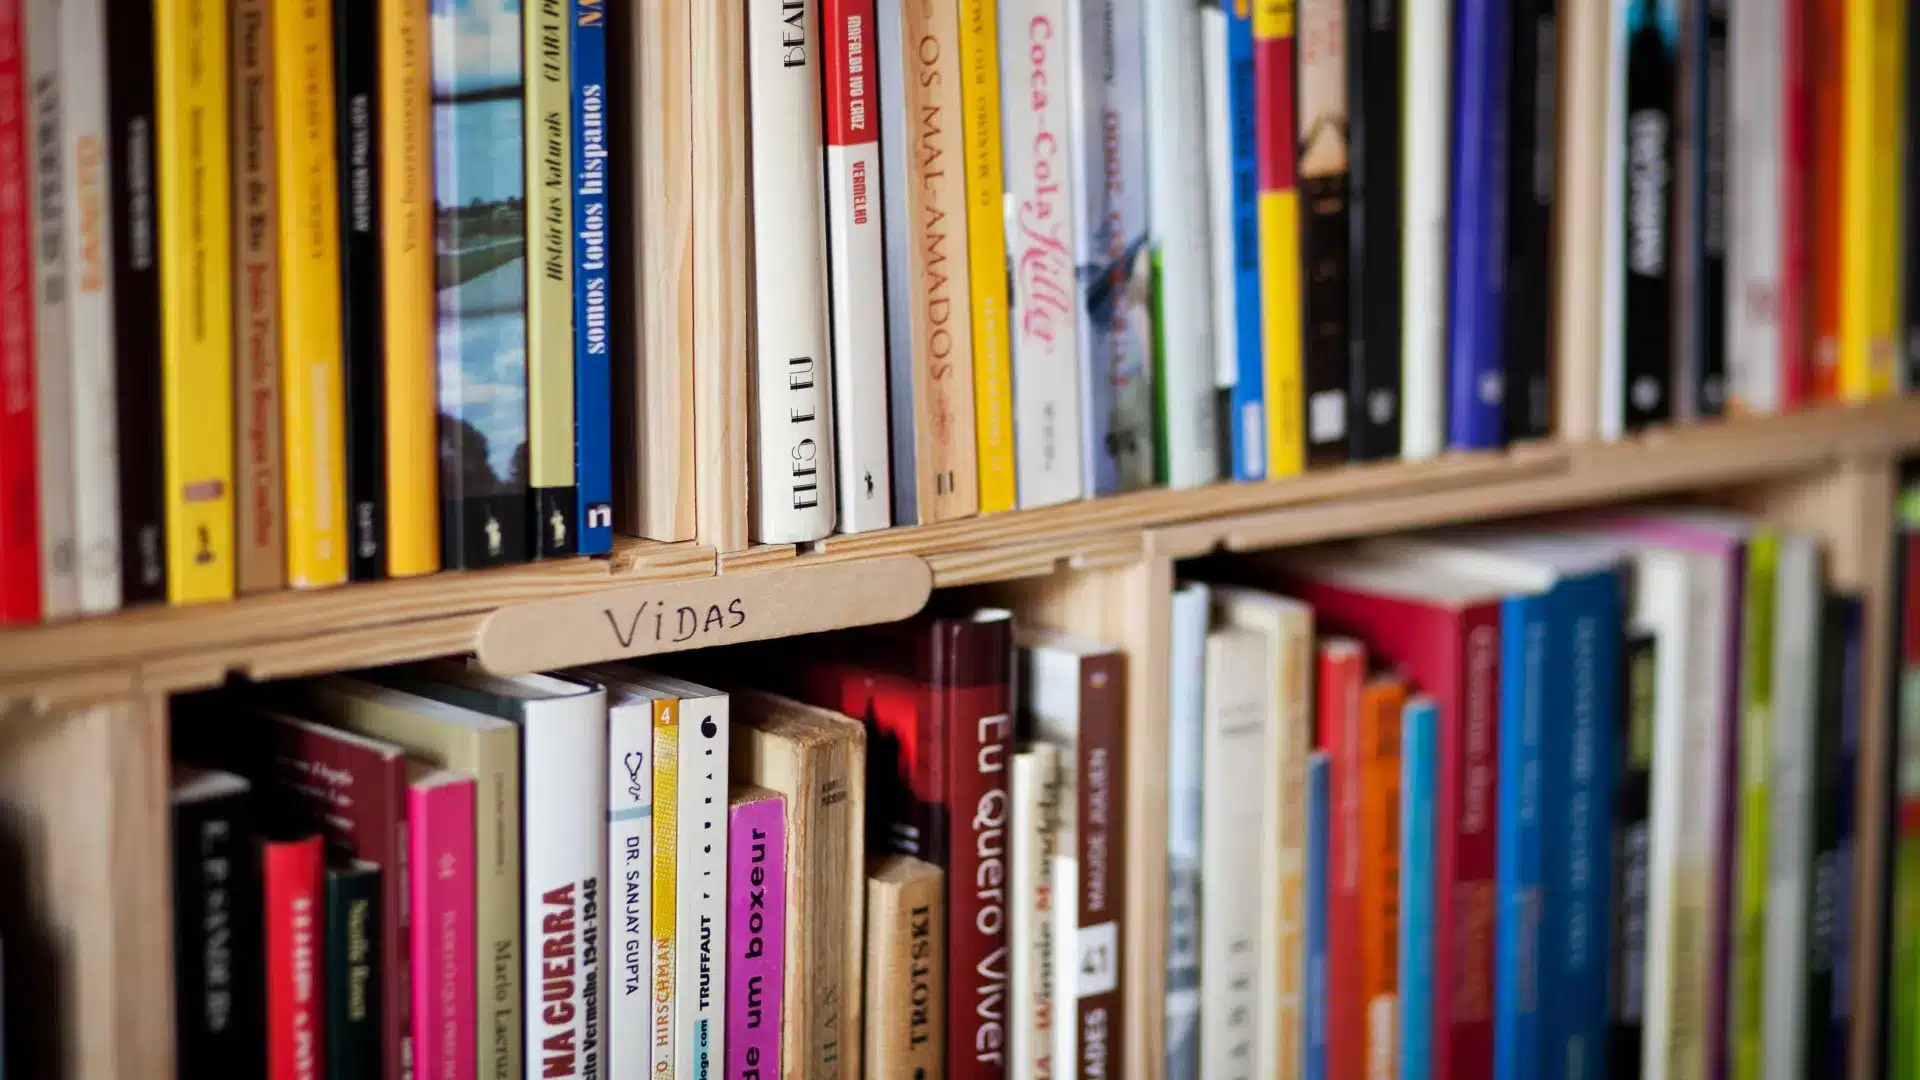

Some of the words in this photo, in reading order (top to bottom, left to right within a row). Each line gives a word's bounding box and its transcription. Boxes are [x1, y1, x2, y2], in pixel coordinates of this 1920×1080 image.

[846, 15, 861, 73] MAFALDA
[918, 34, 942, 89] OS
[849, 76, 862, 98] IVO
[850, 100, 864, 131] CRUZ
[1029, 14, 1058, 221] Coca-Cola
[579, 85, 607, 194] hispanos
[852, 160, 867, 225] VERMELHO
[581, 201, 604, 271] todos
[921, 105, 953, 381] MAL-AMADOS
[1019, 200, 1071, 346] Killer
[586, 278, 605, 355] somos
[789, 356, 814, 391] EU
[791, 404, 814, 425] E
[793, 437, 817, 510] ELES
[604, 597, 747, 648] VIDAS
[660, 706, 672, 725] 4
[978, 713, 1008, 773] Eu
[626, 836, 641, 866] DR.
[703, 749, 713, 899] FIGURAS
[744, 827, 767, 959] boxeur
[971, 789, 1008, 935] Quero
[583, 877, 598, 966] 1941-1945
[626, 870, 641, 934] SANJAY
[495, 939, 513, 1003] Mario
[541, 882, 576, 1025] GUERRA
[626, 940, 641, 996] GUPTA
[700, 915, 711, 1011] TRUFFAUT
[909, 903, 930, 1050] TROTSKI
[655, 937, 670, 1047] HIRSCHMAN
[747, 976, 763, 1029] um
[976, 948, 1007, 1065] Viver
[495, 1008, 513, 1080] Lacruz
[542, 1027, 576, 1080] NA
[744, 1047, 761, 1080] de
